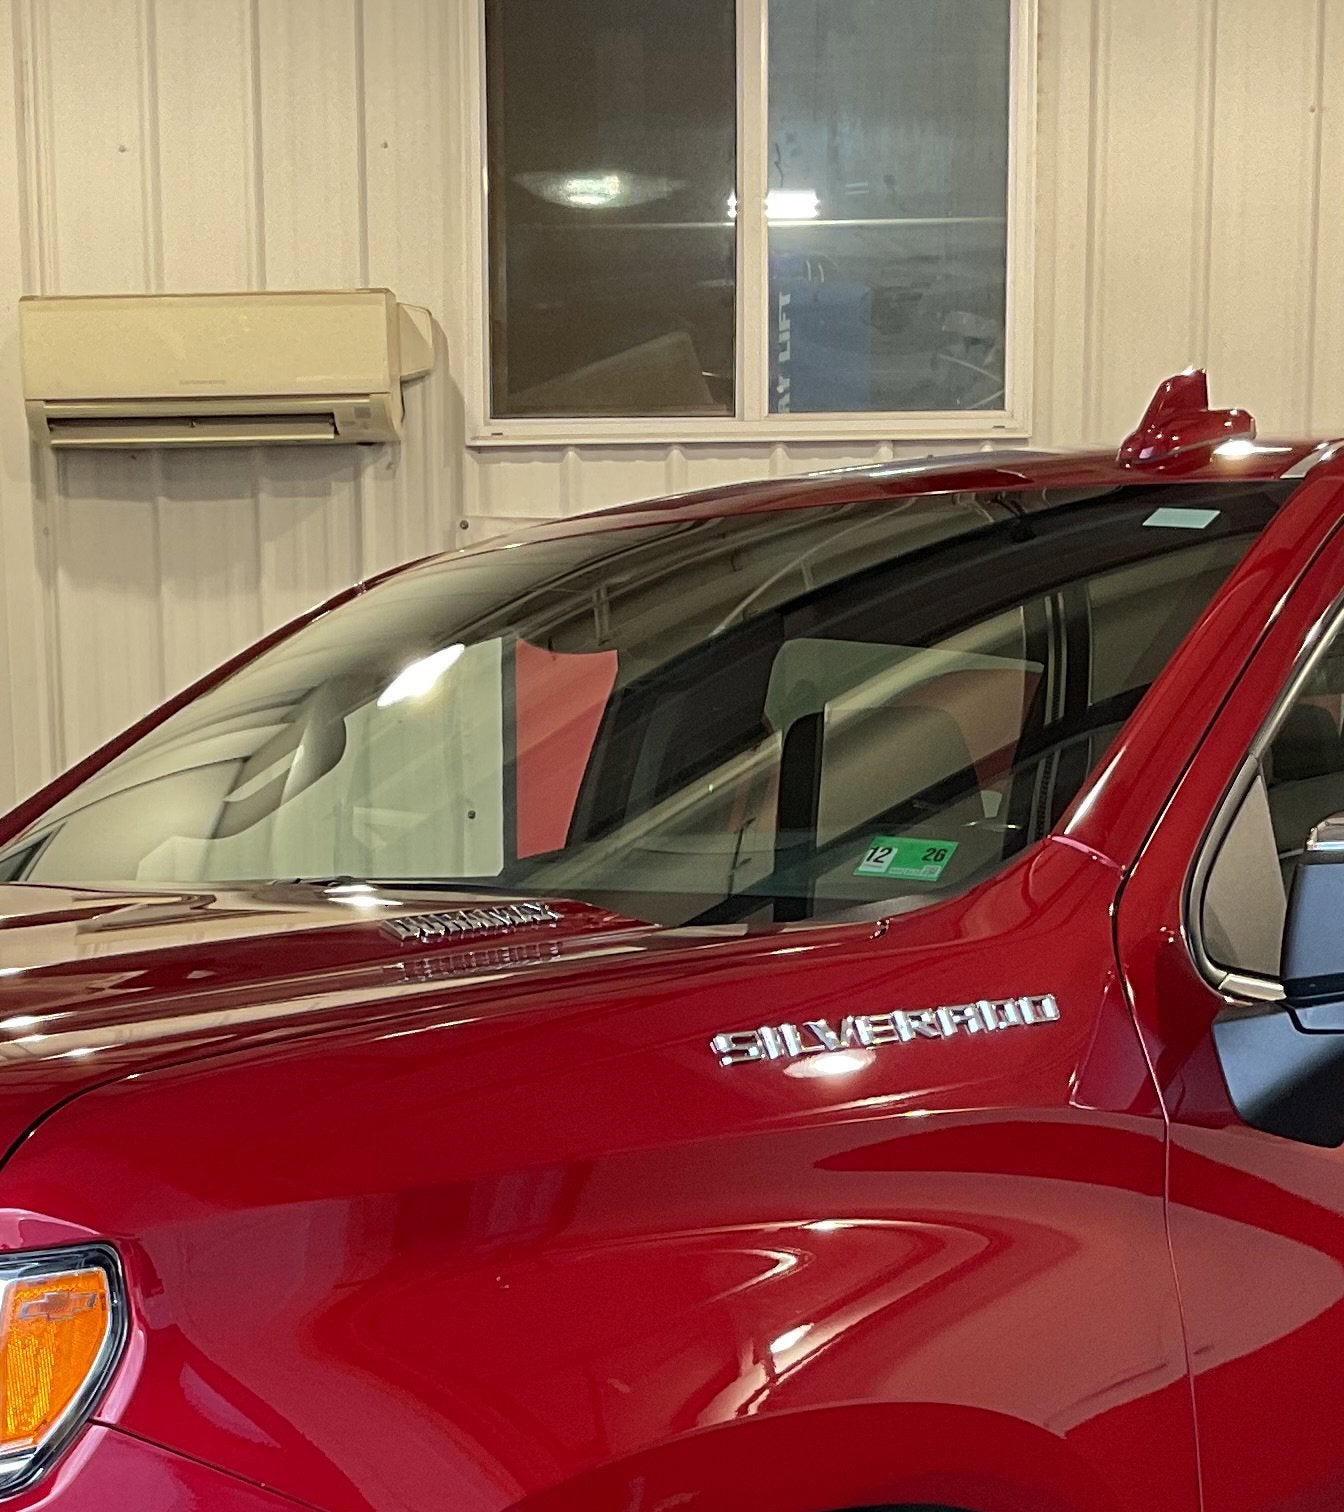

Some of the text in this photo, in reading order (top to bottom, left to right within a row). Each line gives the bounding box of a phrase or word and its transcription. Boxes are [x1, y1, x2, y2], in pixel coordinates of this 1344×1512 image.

[778, 291, 792, 361] LIFT
[865, 845, 948, 864] 12 26
[709, 993, 1061, 1067] SILVERADO
